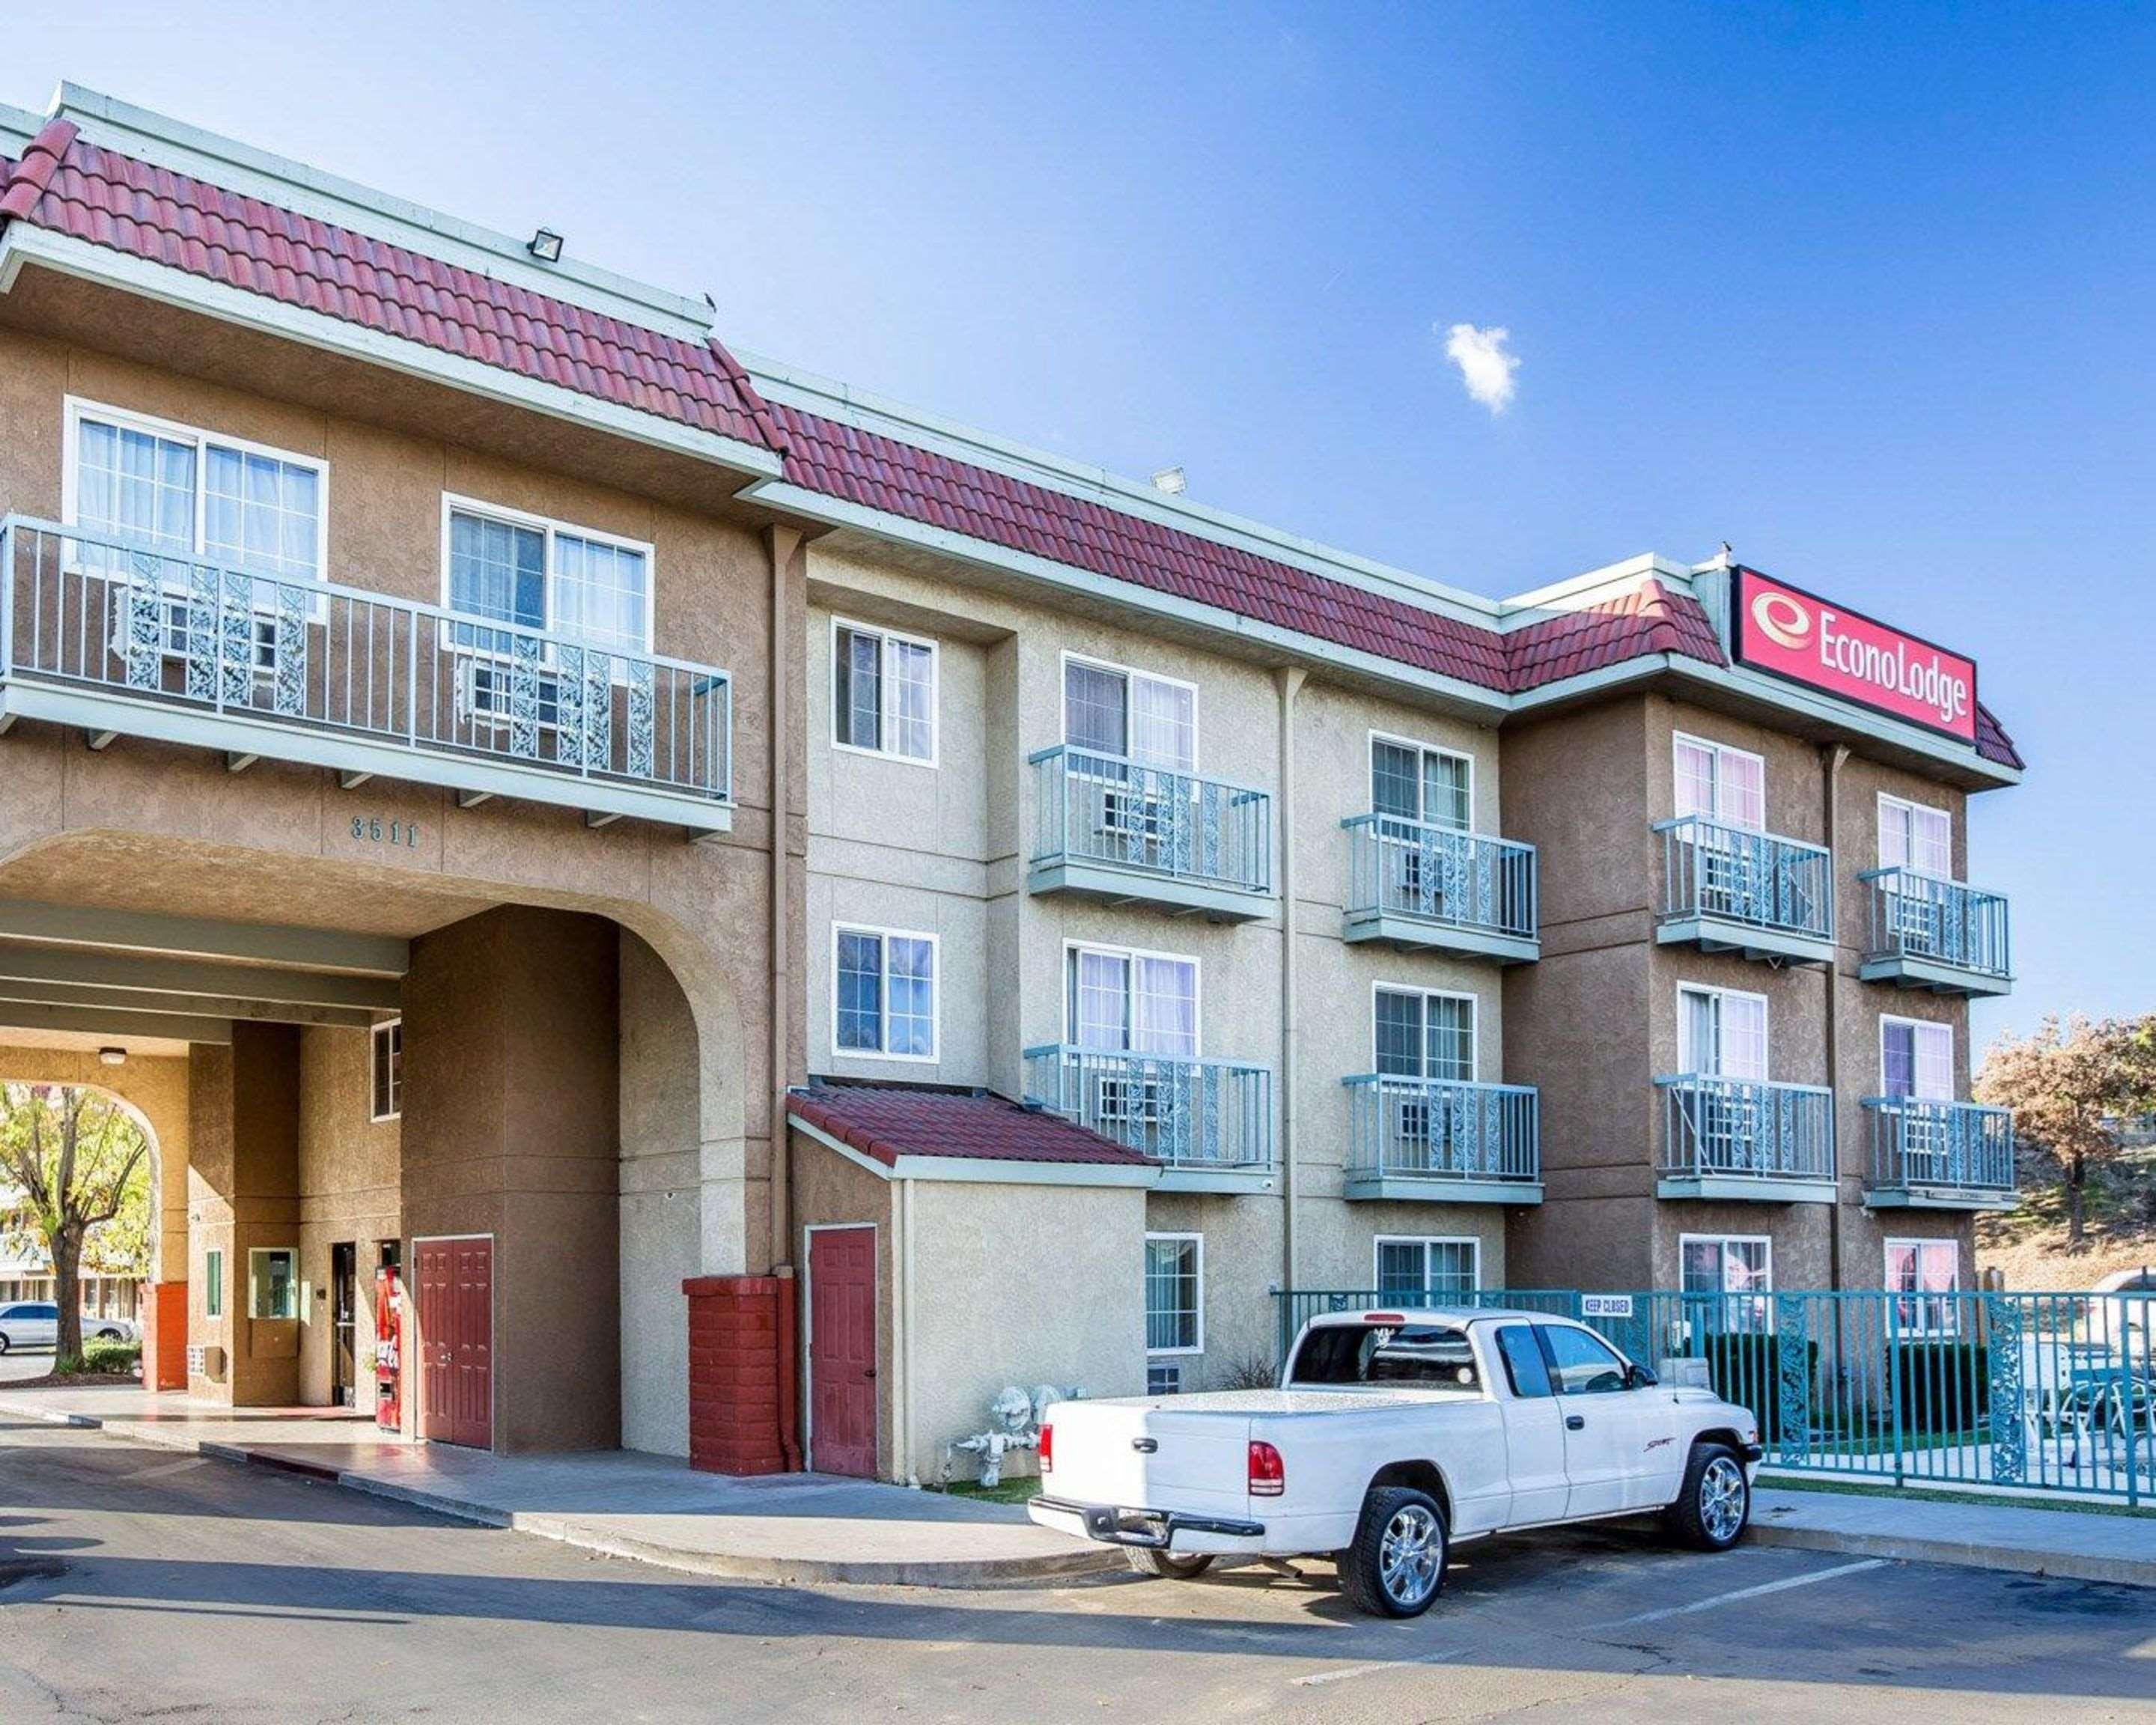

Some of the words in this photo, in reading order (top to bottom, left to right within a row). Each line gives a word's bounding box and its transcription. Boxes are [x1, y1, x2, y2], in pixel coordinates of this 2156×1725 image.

[351, 816, 417, 848] 3511
[1586, 1299, 1601, 1312] KEEP
[1604, 1300, 1630, 1313] CLOSED
